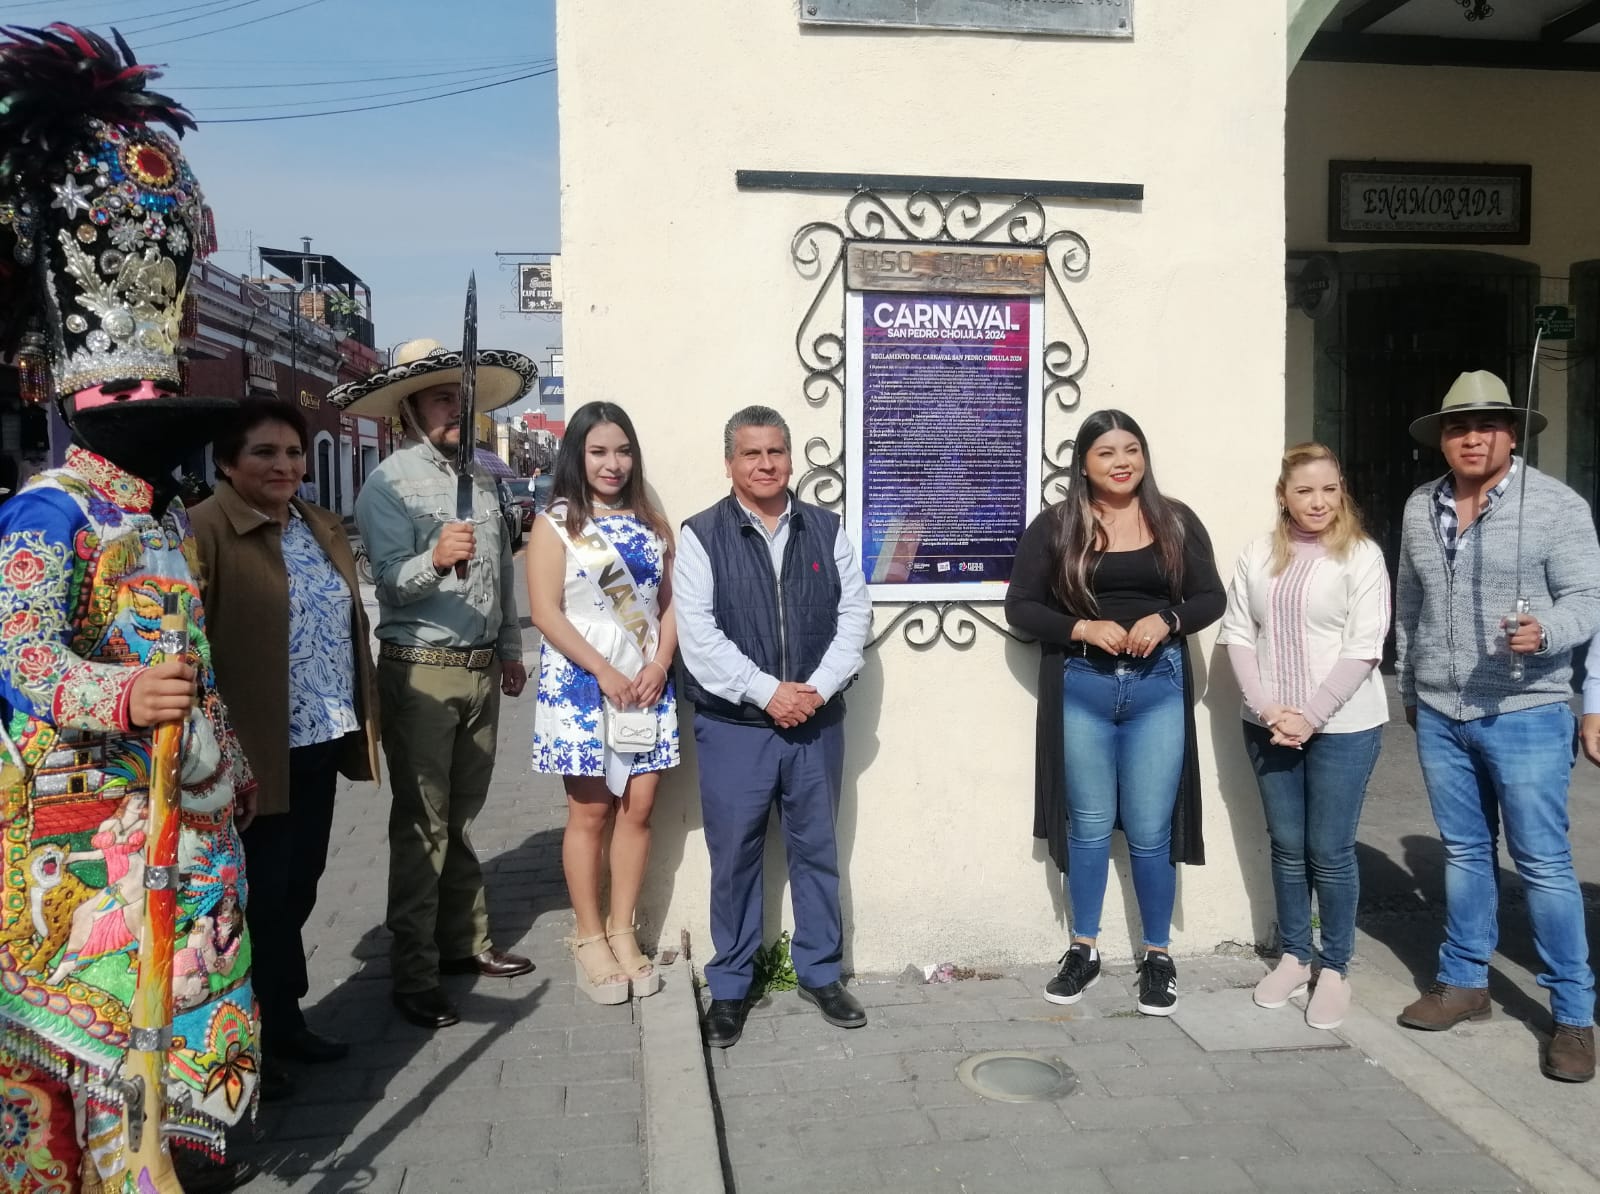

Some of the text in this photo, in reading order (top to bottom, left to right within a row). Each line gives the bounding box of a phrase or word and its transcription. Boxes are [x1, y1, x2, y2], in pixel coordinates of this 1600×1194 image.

[1362, 184, 1503, 220] ENAMORADA
[873, 302, 1020, 331] CARNAVAL
[887, 328, 1006, 340] SAN PEDRO CHOLULA 2024
